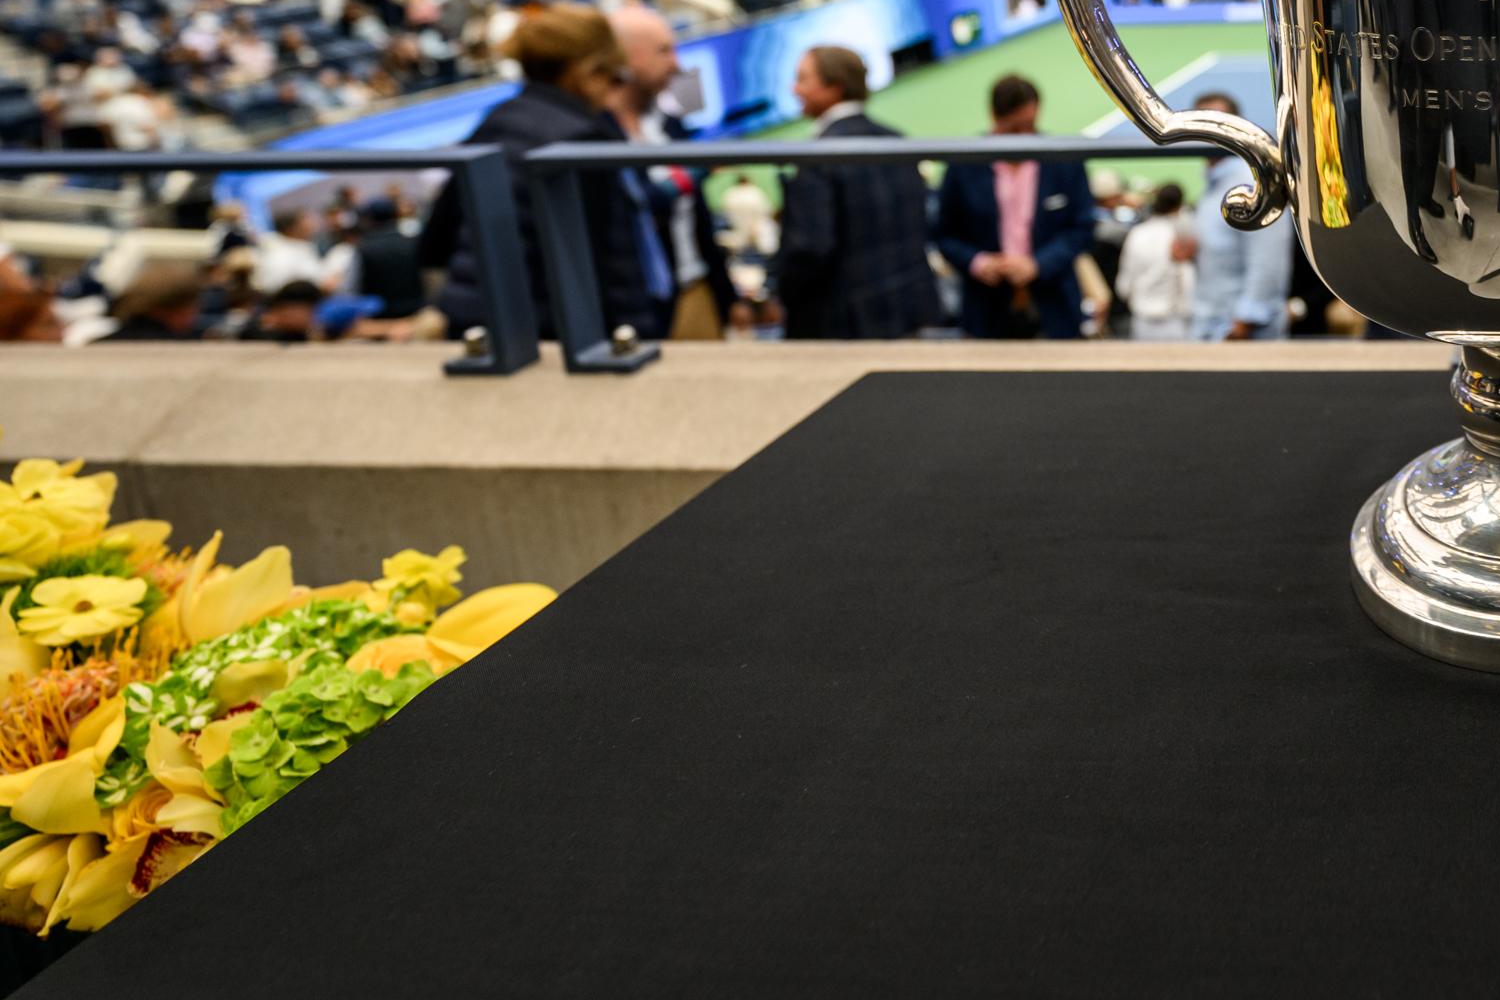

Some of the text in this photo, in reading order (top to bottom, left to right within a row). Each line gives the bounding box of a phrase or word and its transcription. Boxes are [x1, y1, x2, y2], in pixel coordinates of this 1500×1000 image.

[1311, 20, 1400, 60] STATES
[1411, 26, 1497, 61] OPEN
[1402, 88, 1492, 111] MEN'S
